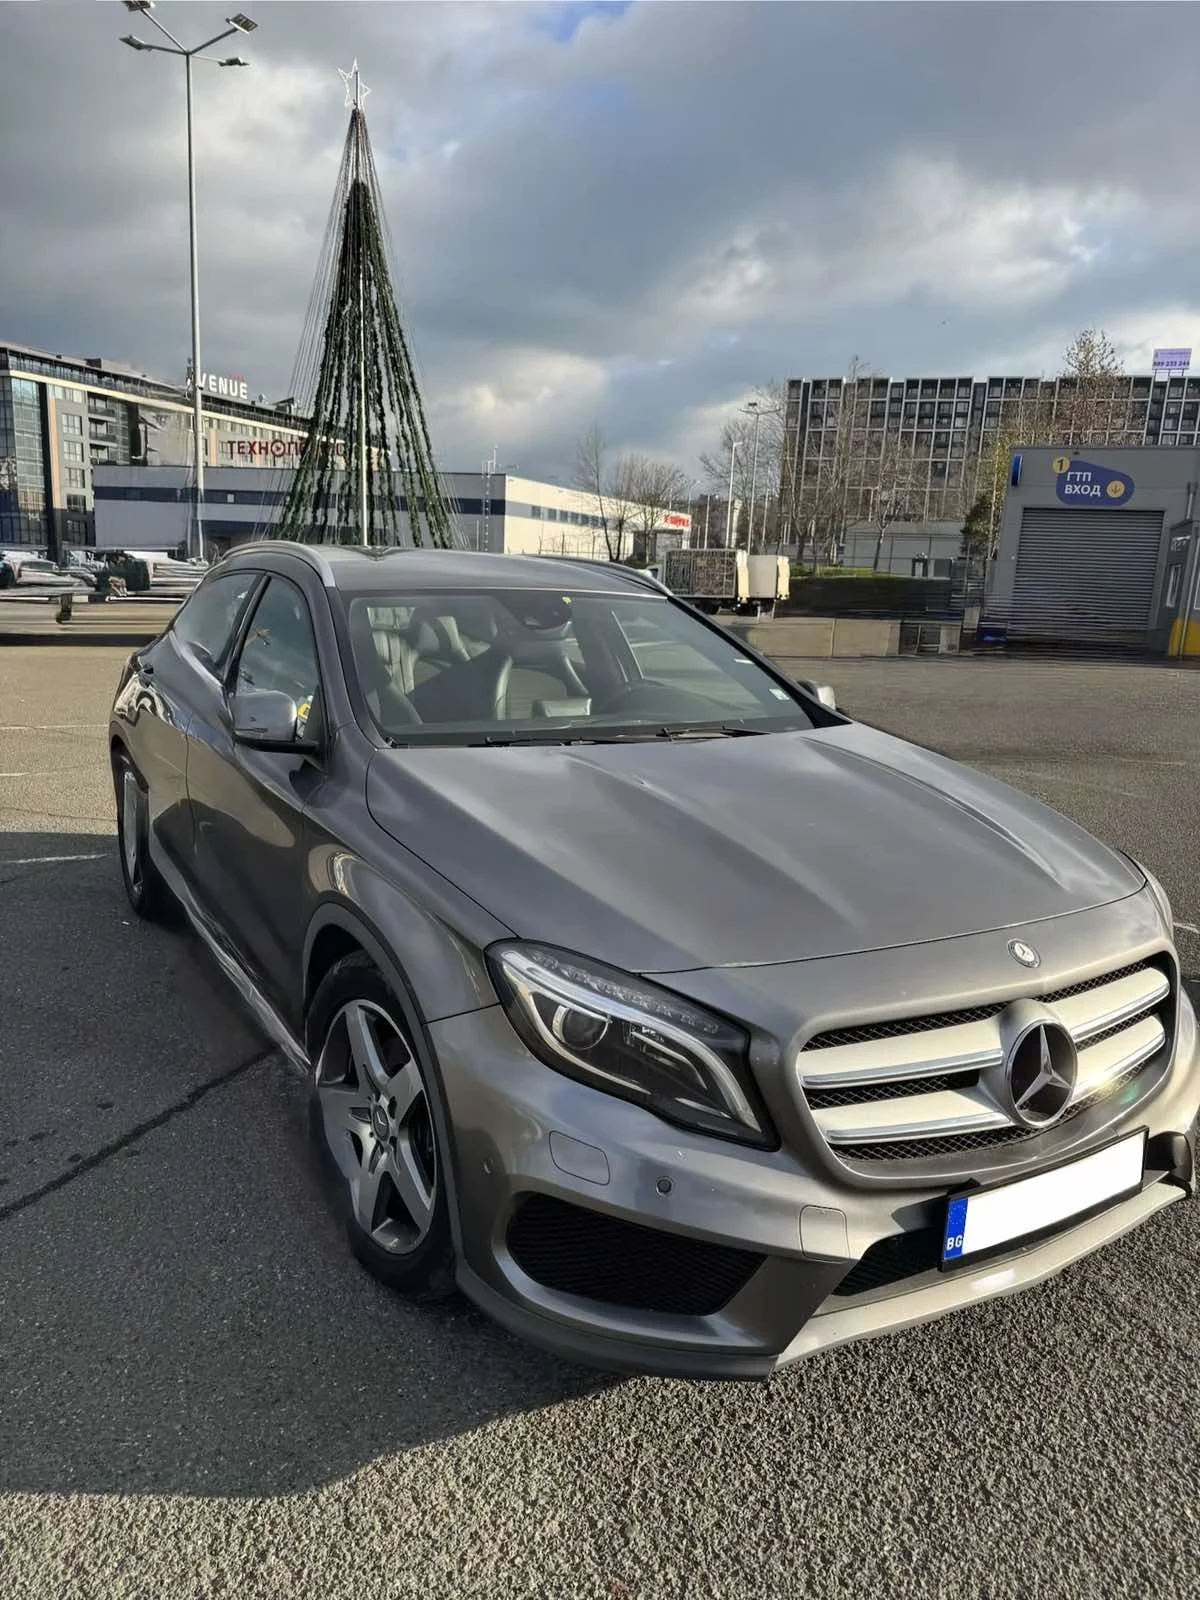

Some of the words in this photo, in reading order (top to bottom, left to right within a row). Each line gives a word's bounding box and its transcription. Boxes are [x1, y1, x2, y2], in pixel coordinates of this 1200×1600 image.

[187, 372, 248, 400] VENUE
[1057, 459, 1065, 471] 1
[1066, 471, 1092, 482] ГТП
[1064, 484, 1101, 497] ВХОД
[946, 1234, 964, 1251] BG
